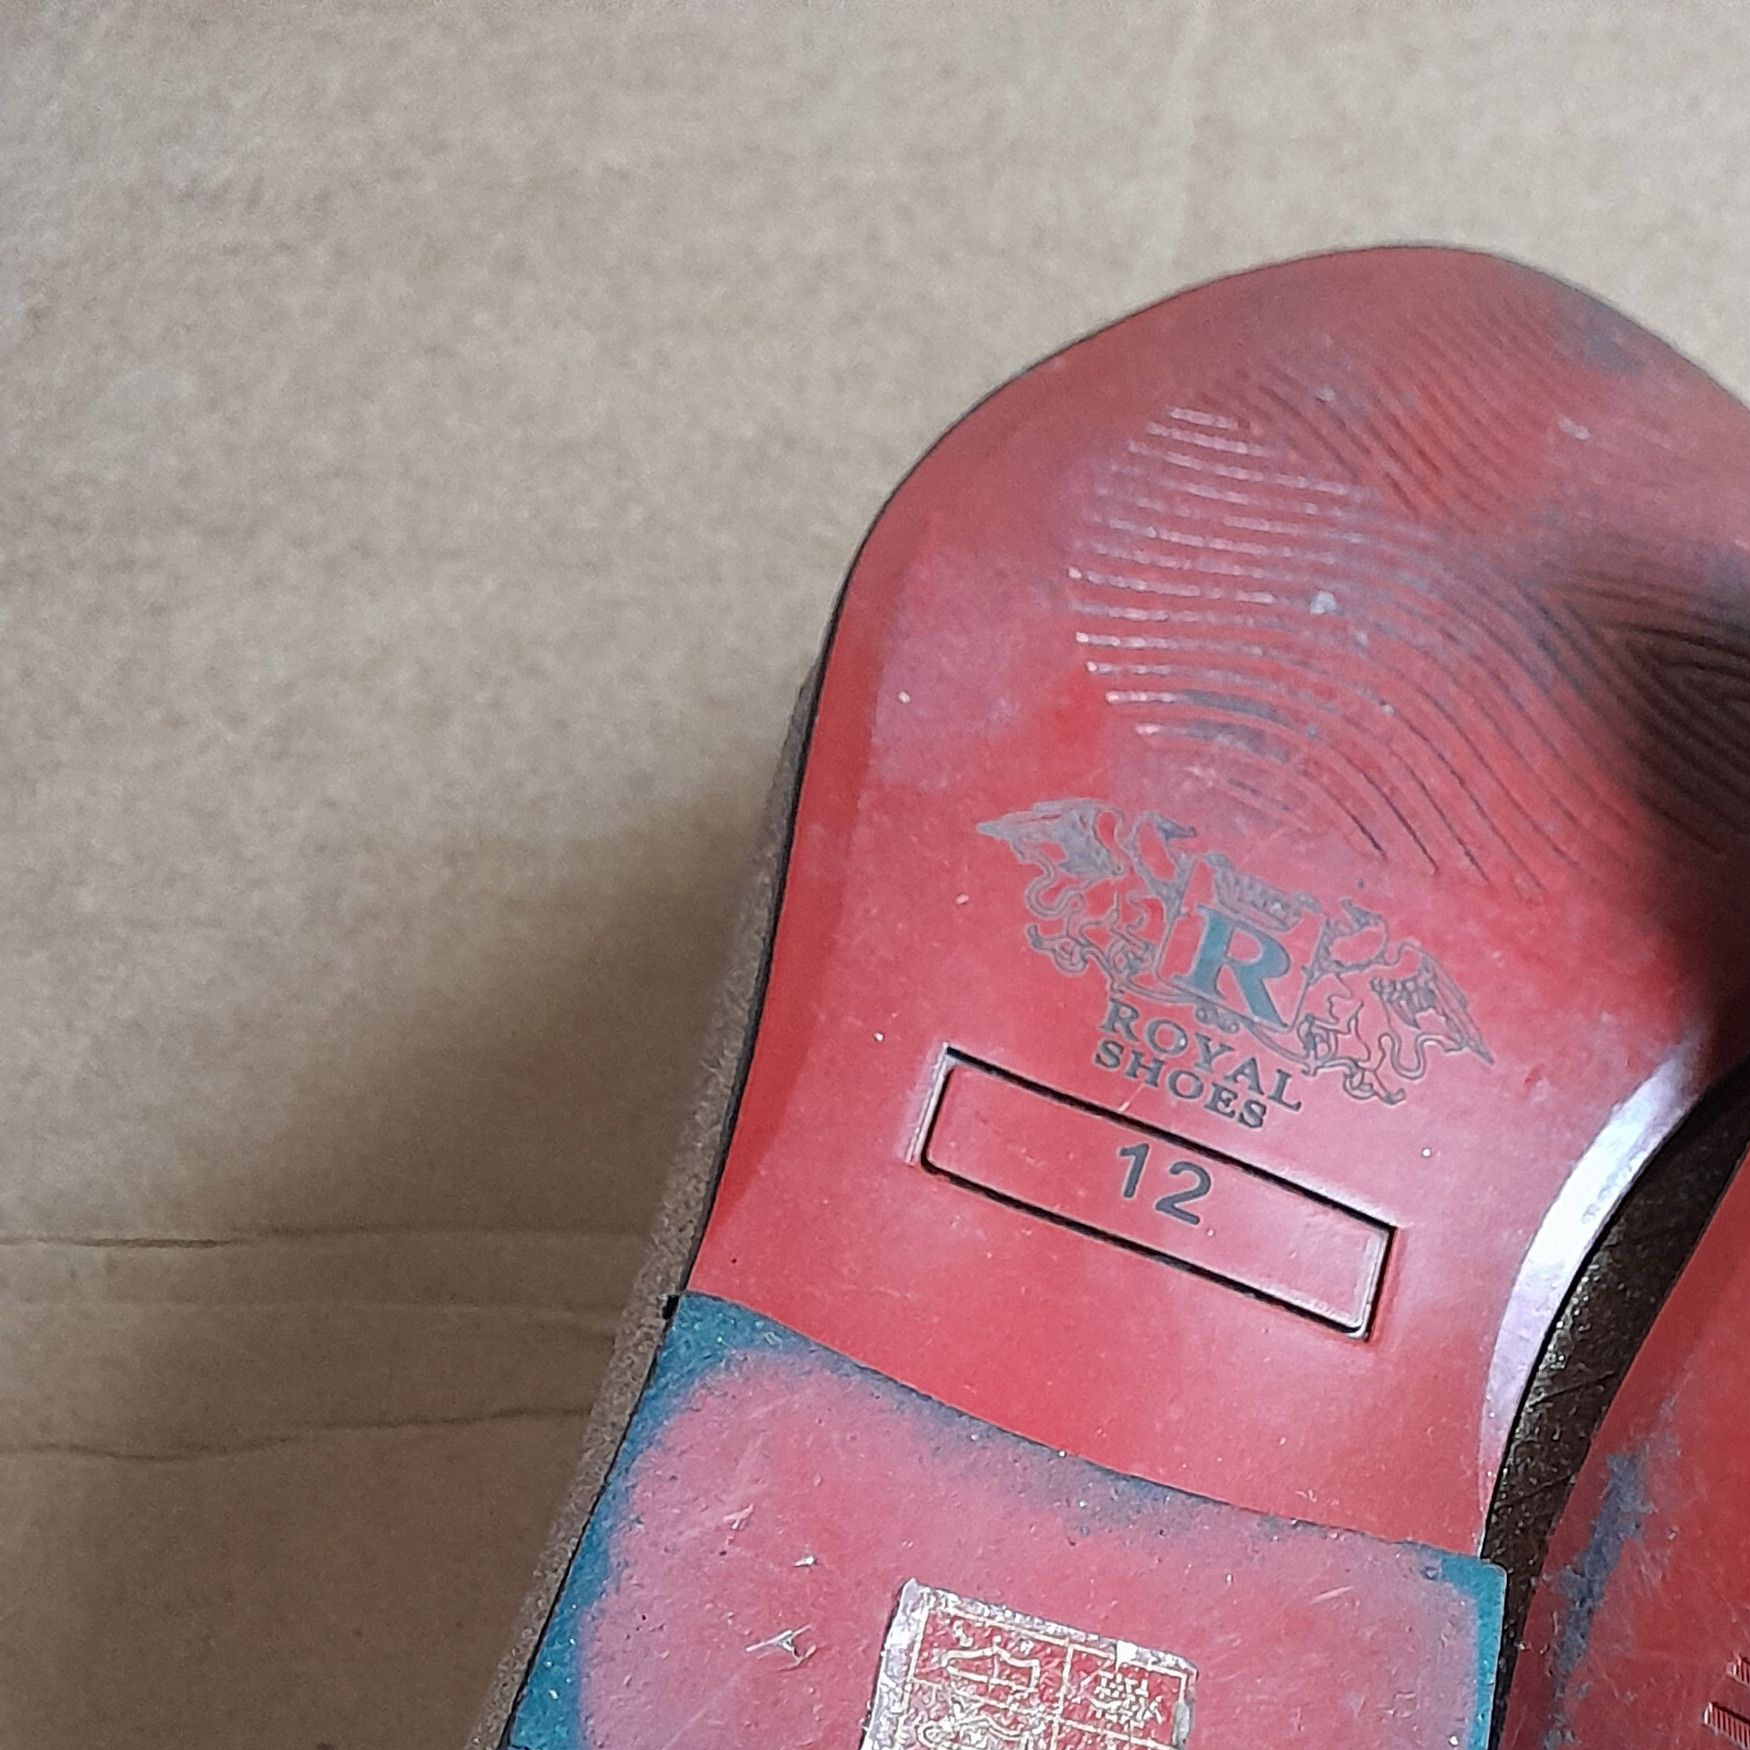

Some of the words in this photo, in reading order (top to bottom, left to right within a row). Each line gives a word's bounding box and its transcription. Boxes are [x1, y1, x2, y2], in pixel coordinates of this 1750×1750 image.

[1172, 905, 1291, 1029] R
[1094, 1039, 1267, 1128] SHOES
[1099, 998, 1301, 1111] ROYAL
[1118, 1142, 1212, 1226] 12
